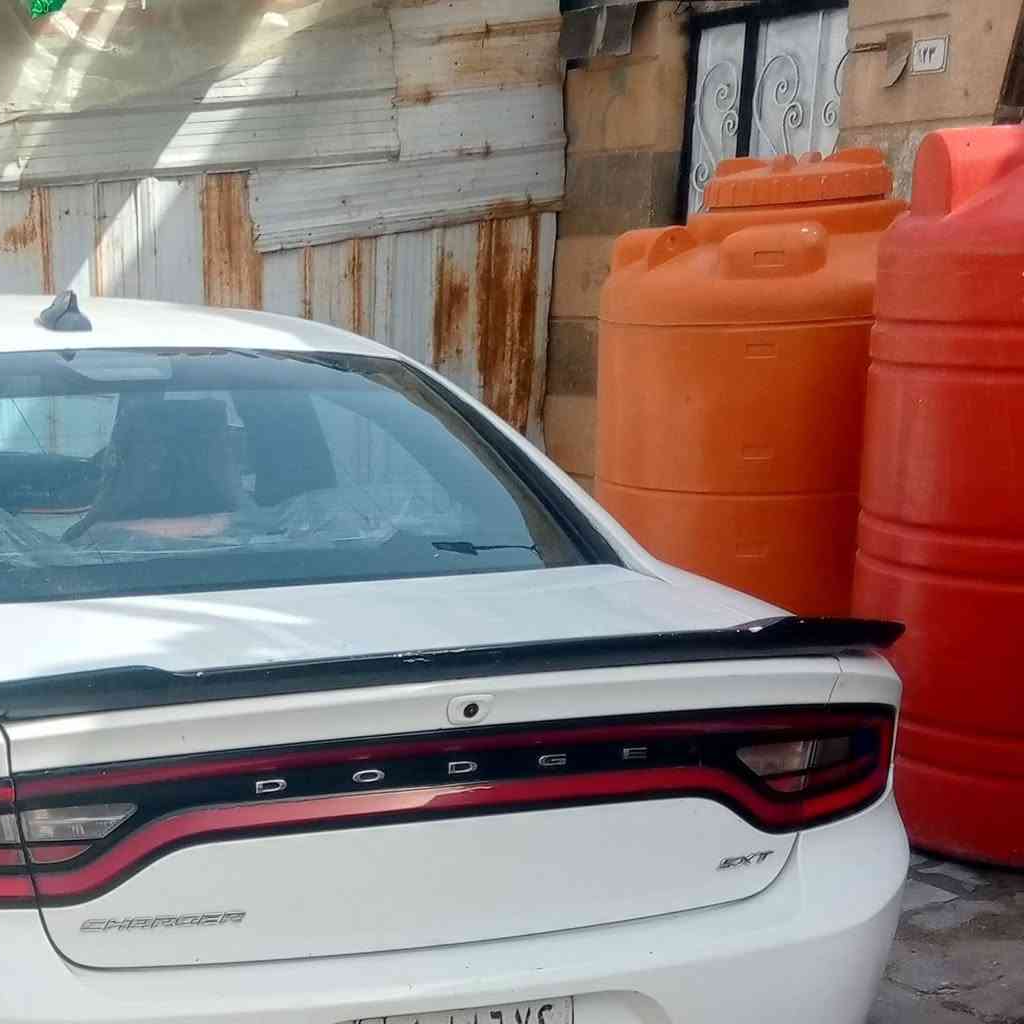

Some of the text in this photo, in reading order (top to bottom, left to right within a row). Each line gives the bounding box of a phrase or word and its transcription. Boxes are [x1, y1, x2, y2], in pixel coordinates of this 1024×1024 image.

[256, 747, 648, 794] DODGE
[716, 850, 774, 869] SXT
[80, 911, 247, 932] CHARGER
